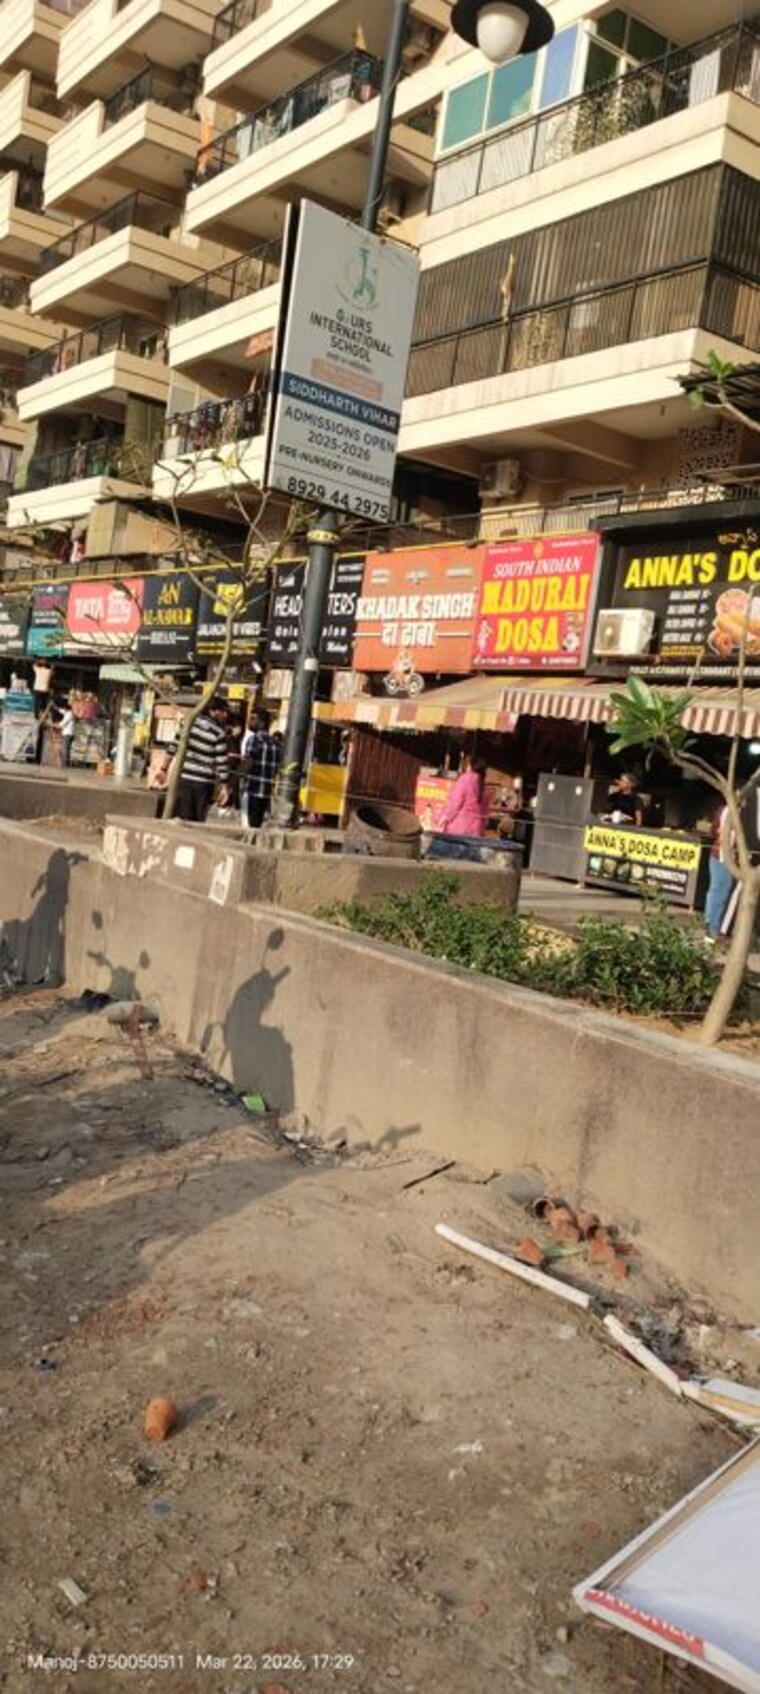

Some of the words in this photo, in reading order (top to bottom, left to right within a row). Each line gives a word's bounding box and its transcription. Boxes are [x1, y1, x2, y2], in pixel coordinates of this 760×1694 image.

[309, 312, 393, 357] INTERNATIONAL
[337, 309, 373, 333] GURS
[330, 336, 371, 363] SCHOOL
[288, 379, 360, 415] SIDDHARTH
[361, 405, 397, 428] VIHAR
[285, 406, 361, 441] ADMISSIONS
[363, 432, 395, 452] OPEN
[308, 430, 371, 461] 2025-2026
[279, 444, 344, 472] PRE-NURSERY
[346, 465, 391, 487] ONWARDS
[287, 476, 326, 499] 8929
[330, 490, 350, 510] 44
[354, 497, 389, 519] 2975
[493, 561, 535, 578] SOUTH
[535, 556, 582, 575] INDIAN
[624, 552, 717, 589] ANNA'S
[74, 597, 105, 620] TATA
[274, 595, 302, 618] HEAD
[356, 597, 420, 620] KHADAK
[421, 593, 475, 619] SINGH
[481, 573, 590, 614] MADURAI
[495, 616, 559, 652] DOSA
[588, 833, 626, 851] ANNA'S
[628, 840, 658, 856] DOSA
[662, 846, 696, 863] CAMP
